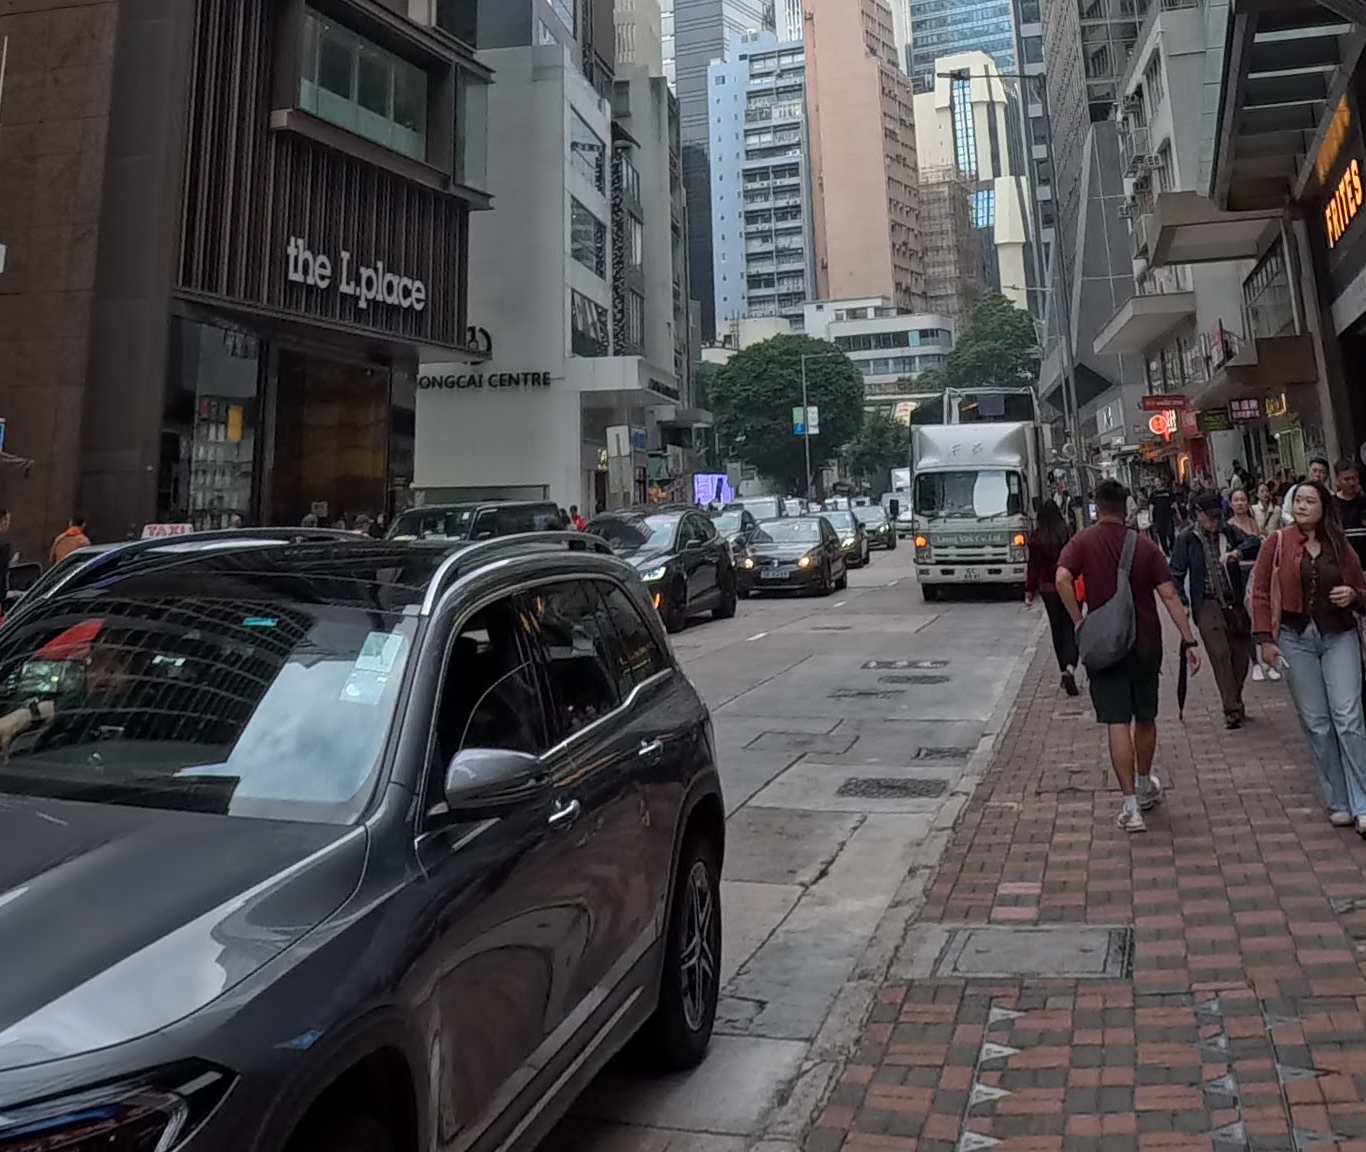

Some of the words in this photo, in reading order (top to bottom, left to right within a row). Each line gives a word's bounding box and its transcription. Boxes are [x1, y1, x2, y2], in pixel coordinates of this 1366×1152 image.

[1324, 158, 1365, 249] FRITES
[287, 236, 332, 289] the
[339, 250, 426, 311] L.place
[488, 371, 551, 388] CENTRE
[147, 525, 186, 537] TAXI
